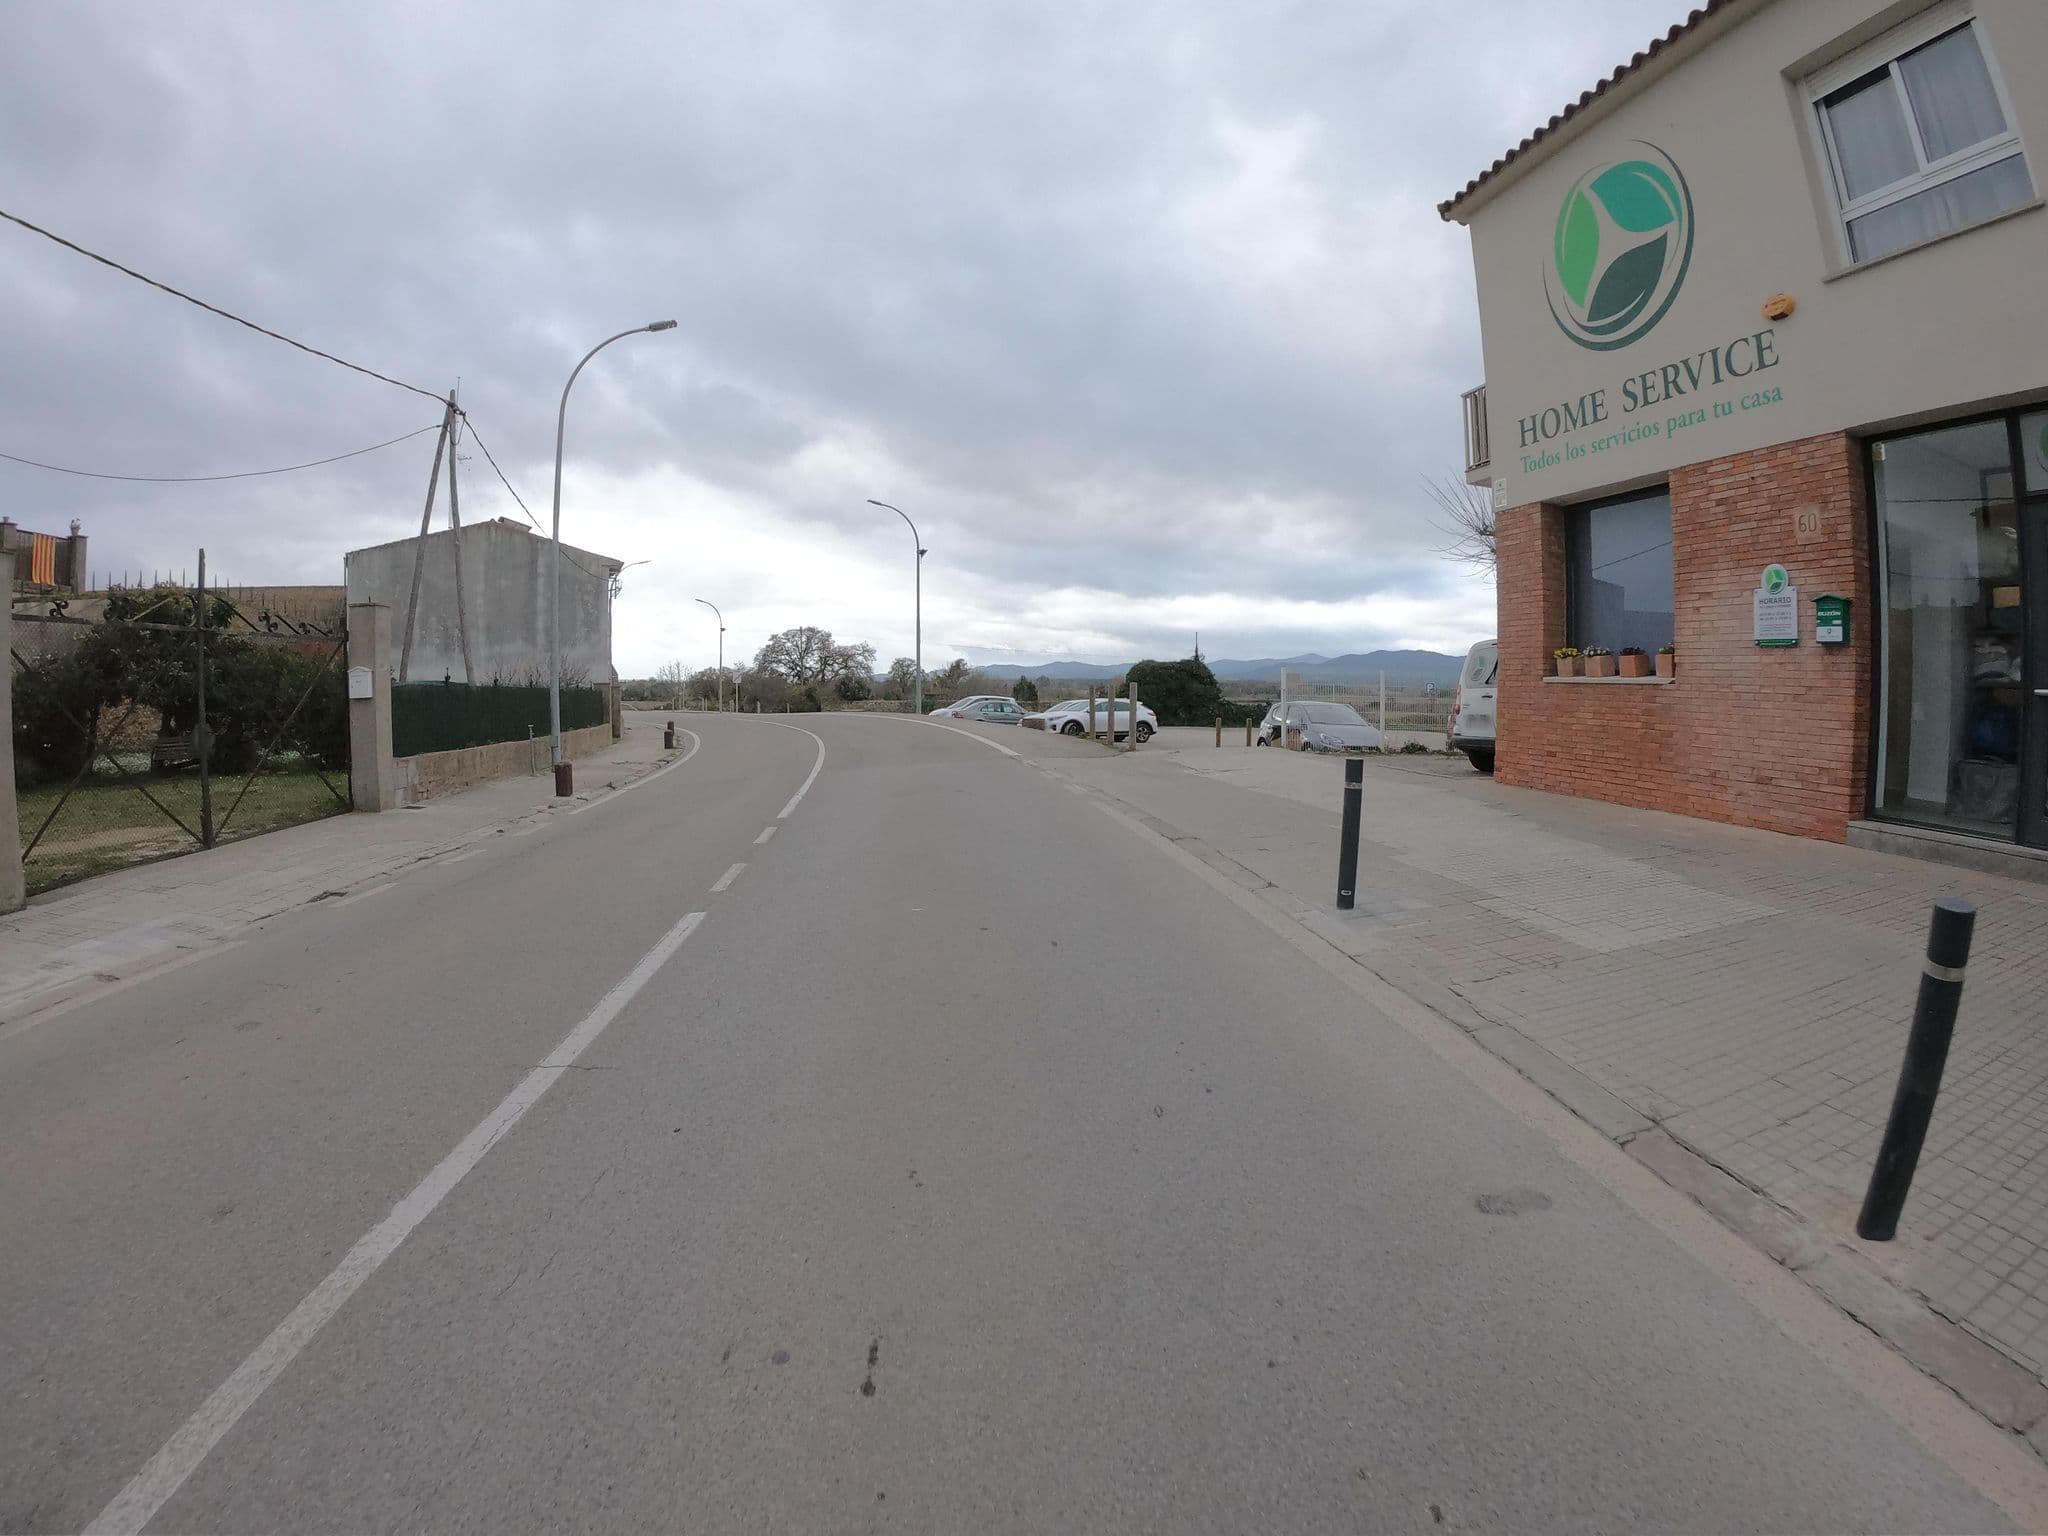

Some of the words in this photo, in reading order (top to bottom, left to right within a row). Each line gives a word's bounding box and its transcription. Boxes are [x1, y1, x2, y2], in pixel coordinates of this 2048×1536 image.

[1517, 389, 1609, 448] HOME
[1621, 329, 1780, 413] SERVICE
[1520, 448, 1560, 474] Todos
[1565, 443, 1586, 461] los
[1591, 420, 1660, 454] servicios
[1667, 408, 1707, 438] para
[1712, 398, 1733, 418] tu
[1740, 386, 1784, 411] casa
[1798, 512, 1817, 532] 60
[1758, 596, 1792, 605] HORARIO
